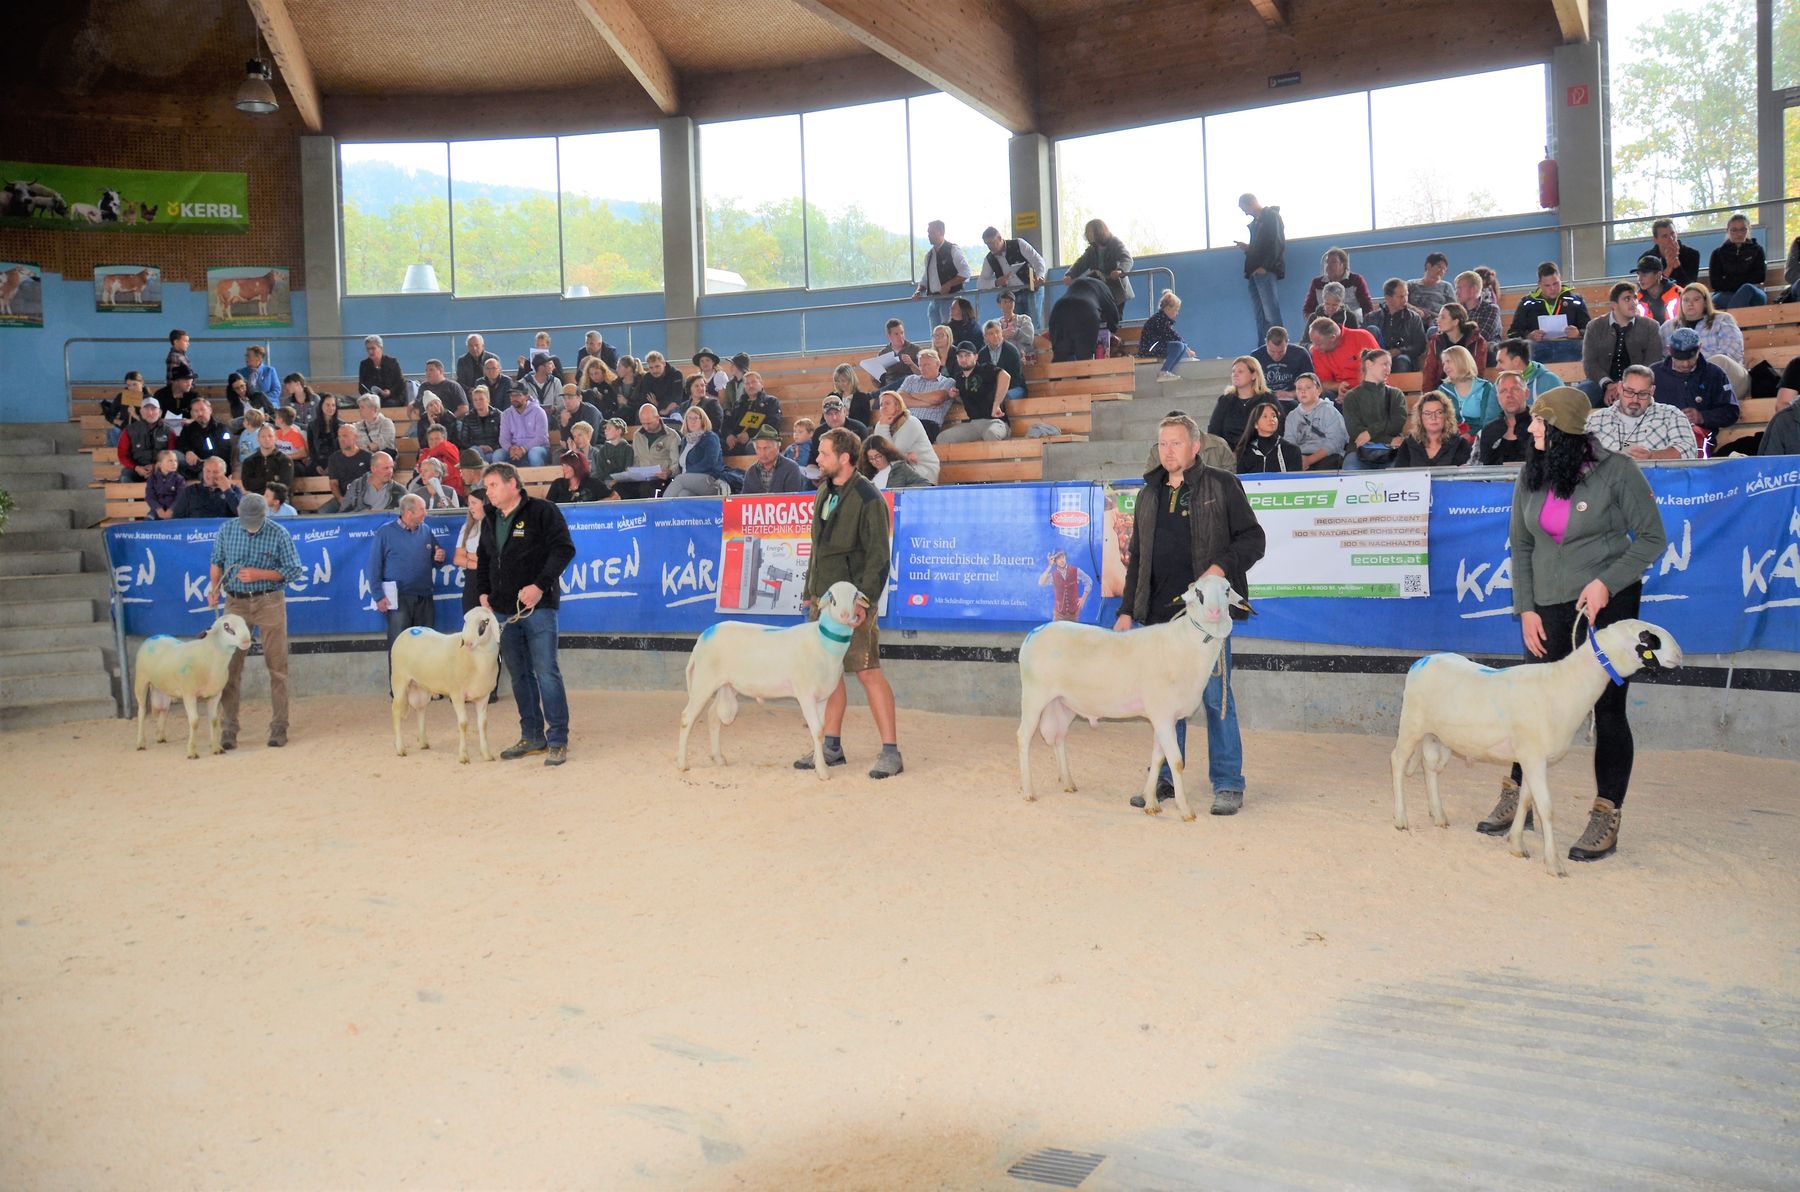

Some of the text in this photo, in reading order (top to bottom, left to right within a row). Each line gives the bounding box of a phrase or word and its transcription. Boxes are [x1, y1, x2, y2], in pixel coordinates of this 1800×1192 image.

[181, 203, 243, 219] KERBL
[1746, 471, 1800, 493] KÄRNTE
[1250, 494, 1328, 507] PELLETS
[1346, 489, 1420, 505] ecolets
[617, 512, 646, 529] KÄRNTEN
[655, 518, 712, 528] www.kaernten.at
[1316, 515, 1421, 525] REGIONALER PRODUZENT
[115, 531, 182, 541] www.kaernten.at
[304, 526, 341, 541] KÄRNTEN
[742, 525, 811, 534] HEIZTECHNIK DER
[1319, 529, 1368, 537] NATÜRLICHE
[1369, 528, 1421, 536] ROHSTOFFE
[910, 537, 956, 549] Wir sind
[910, 552, 1034, 566] österreichische Bauern
[1353, 554, 1421, 564] ecolets.at
[909, 569, 1000, 584] und zwar gerne!
